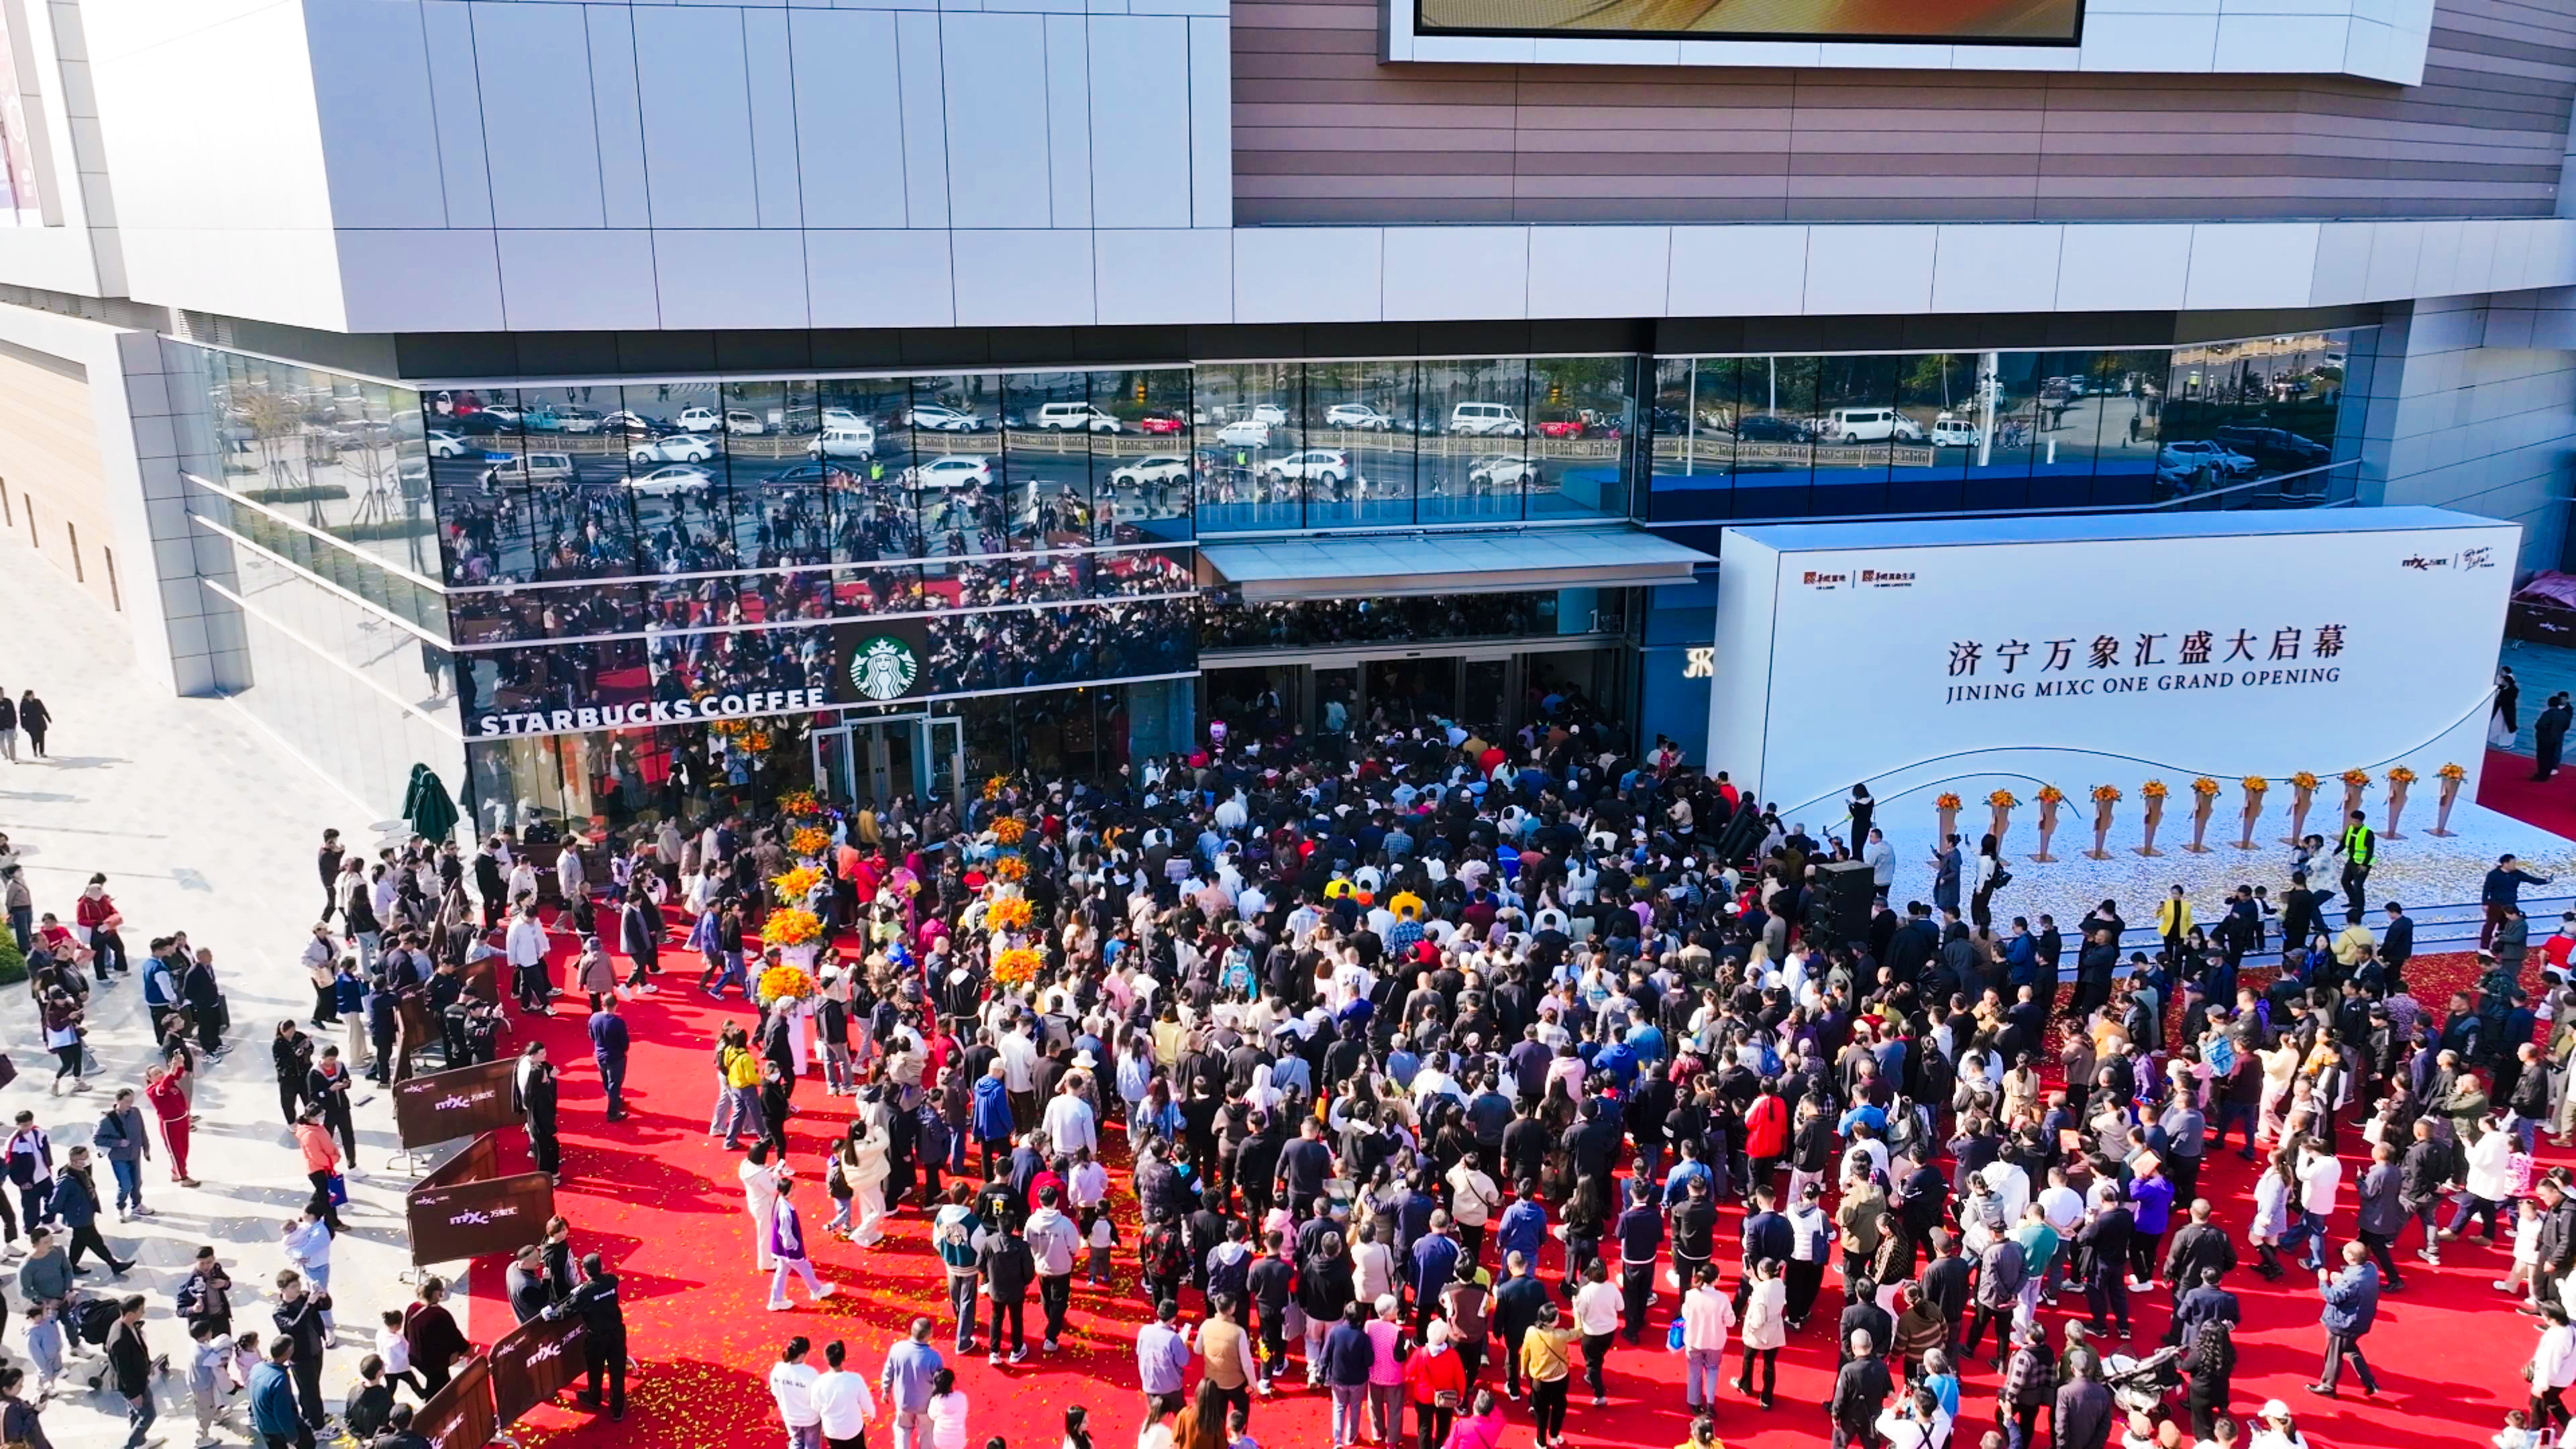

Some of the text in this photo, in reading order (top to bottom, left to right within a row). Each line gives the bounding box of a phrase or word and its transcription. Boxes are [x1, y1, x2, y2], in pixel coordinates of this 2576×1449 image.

[1948, 625, 2347, 676] 济宁万象汇盛大启幕
[1946, 667, 2340, 704] JINING MIXC ONE GRAND OPENING
[480, 687, 824, 737] STARBUCKS COFFEE
